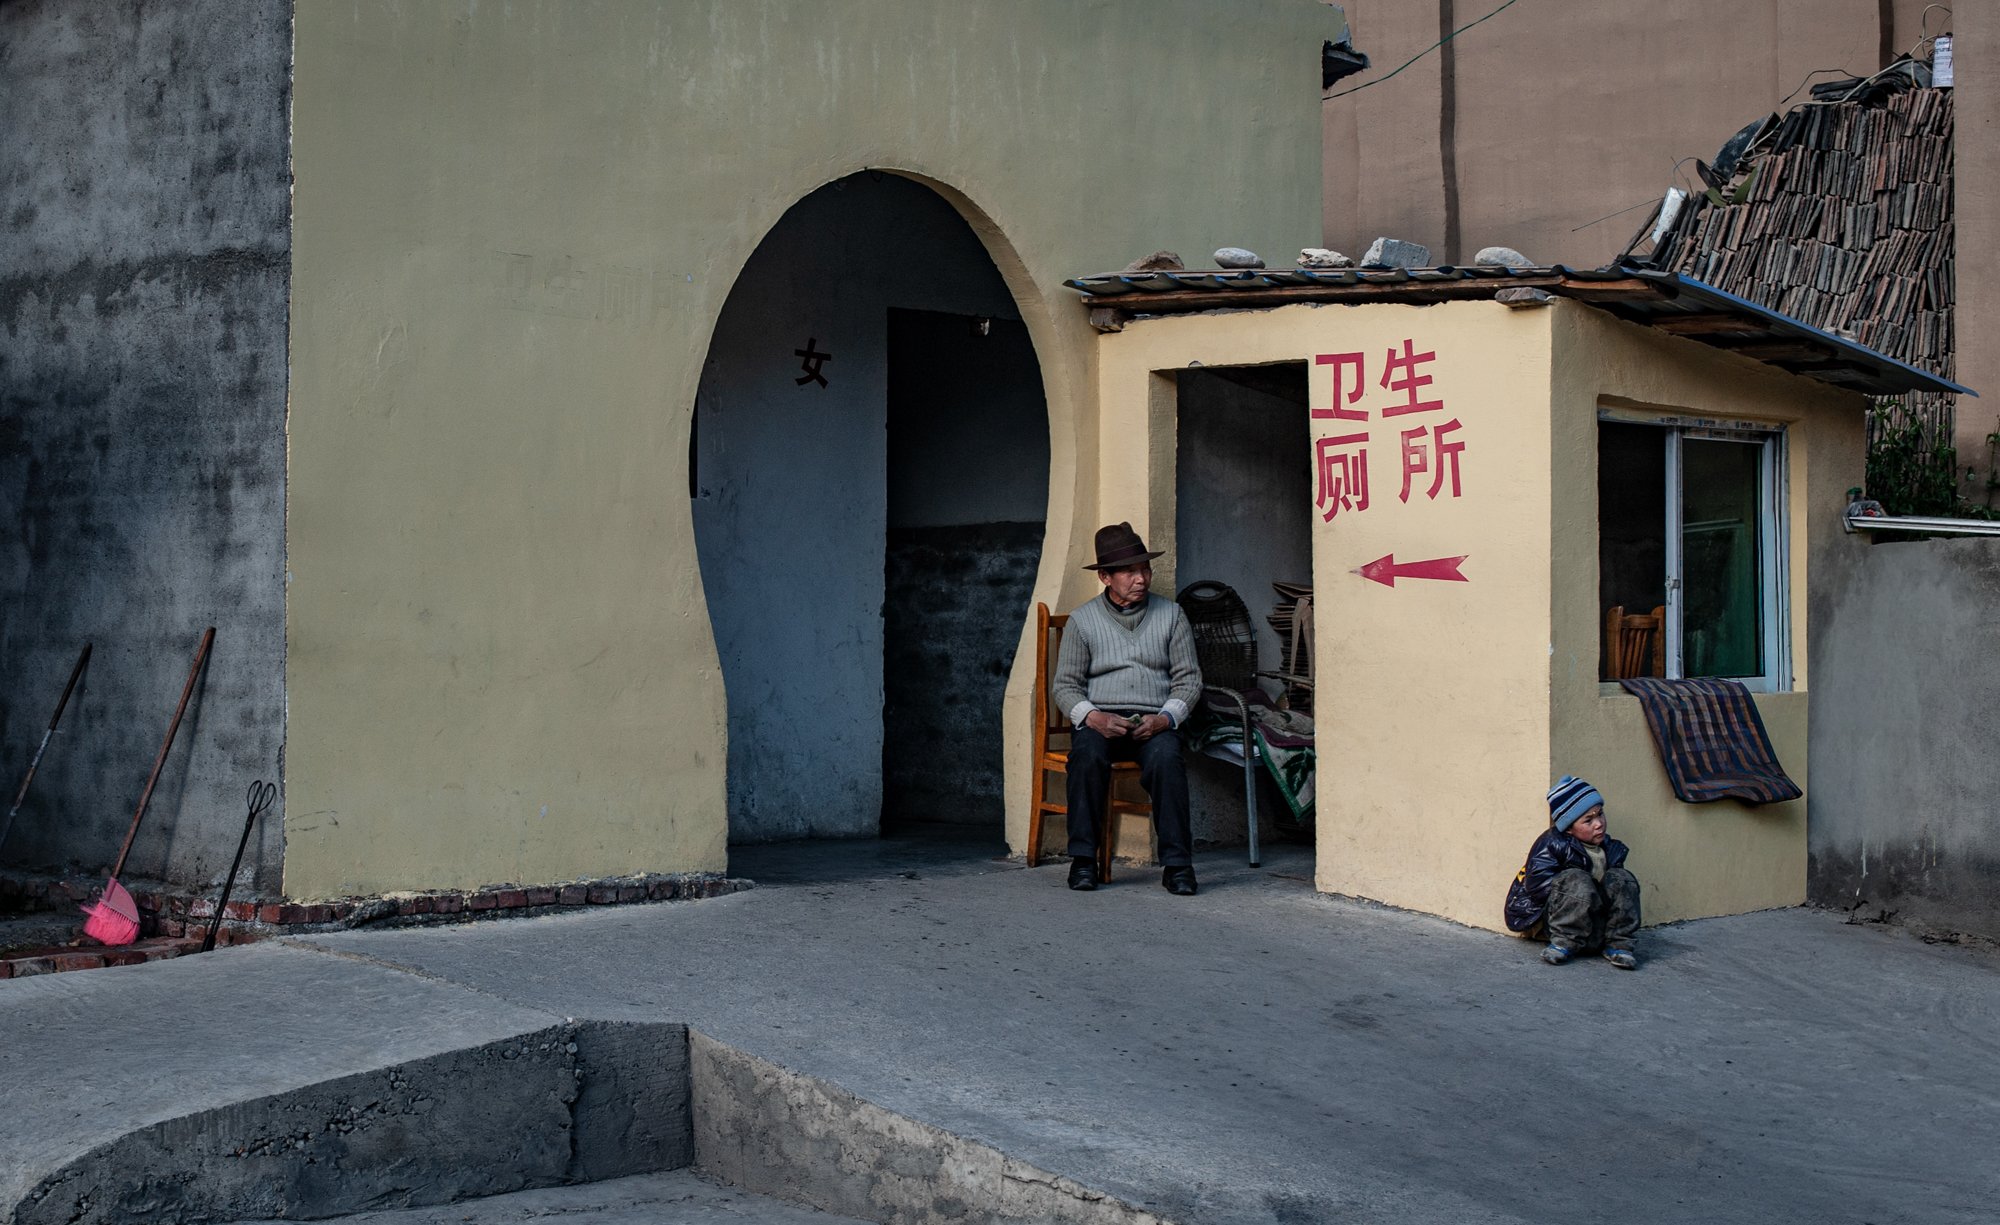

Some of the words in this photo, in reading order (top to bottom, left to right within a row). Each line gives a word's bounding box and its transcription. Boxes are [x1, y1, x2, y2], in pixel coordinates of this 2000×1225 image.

[794, 337, 832, 390] 女
[1311, 338, 1444, 422] 卫生
[1315, 418, 1466, 523] 厕所
